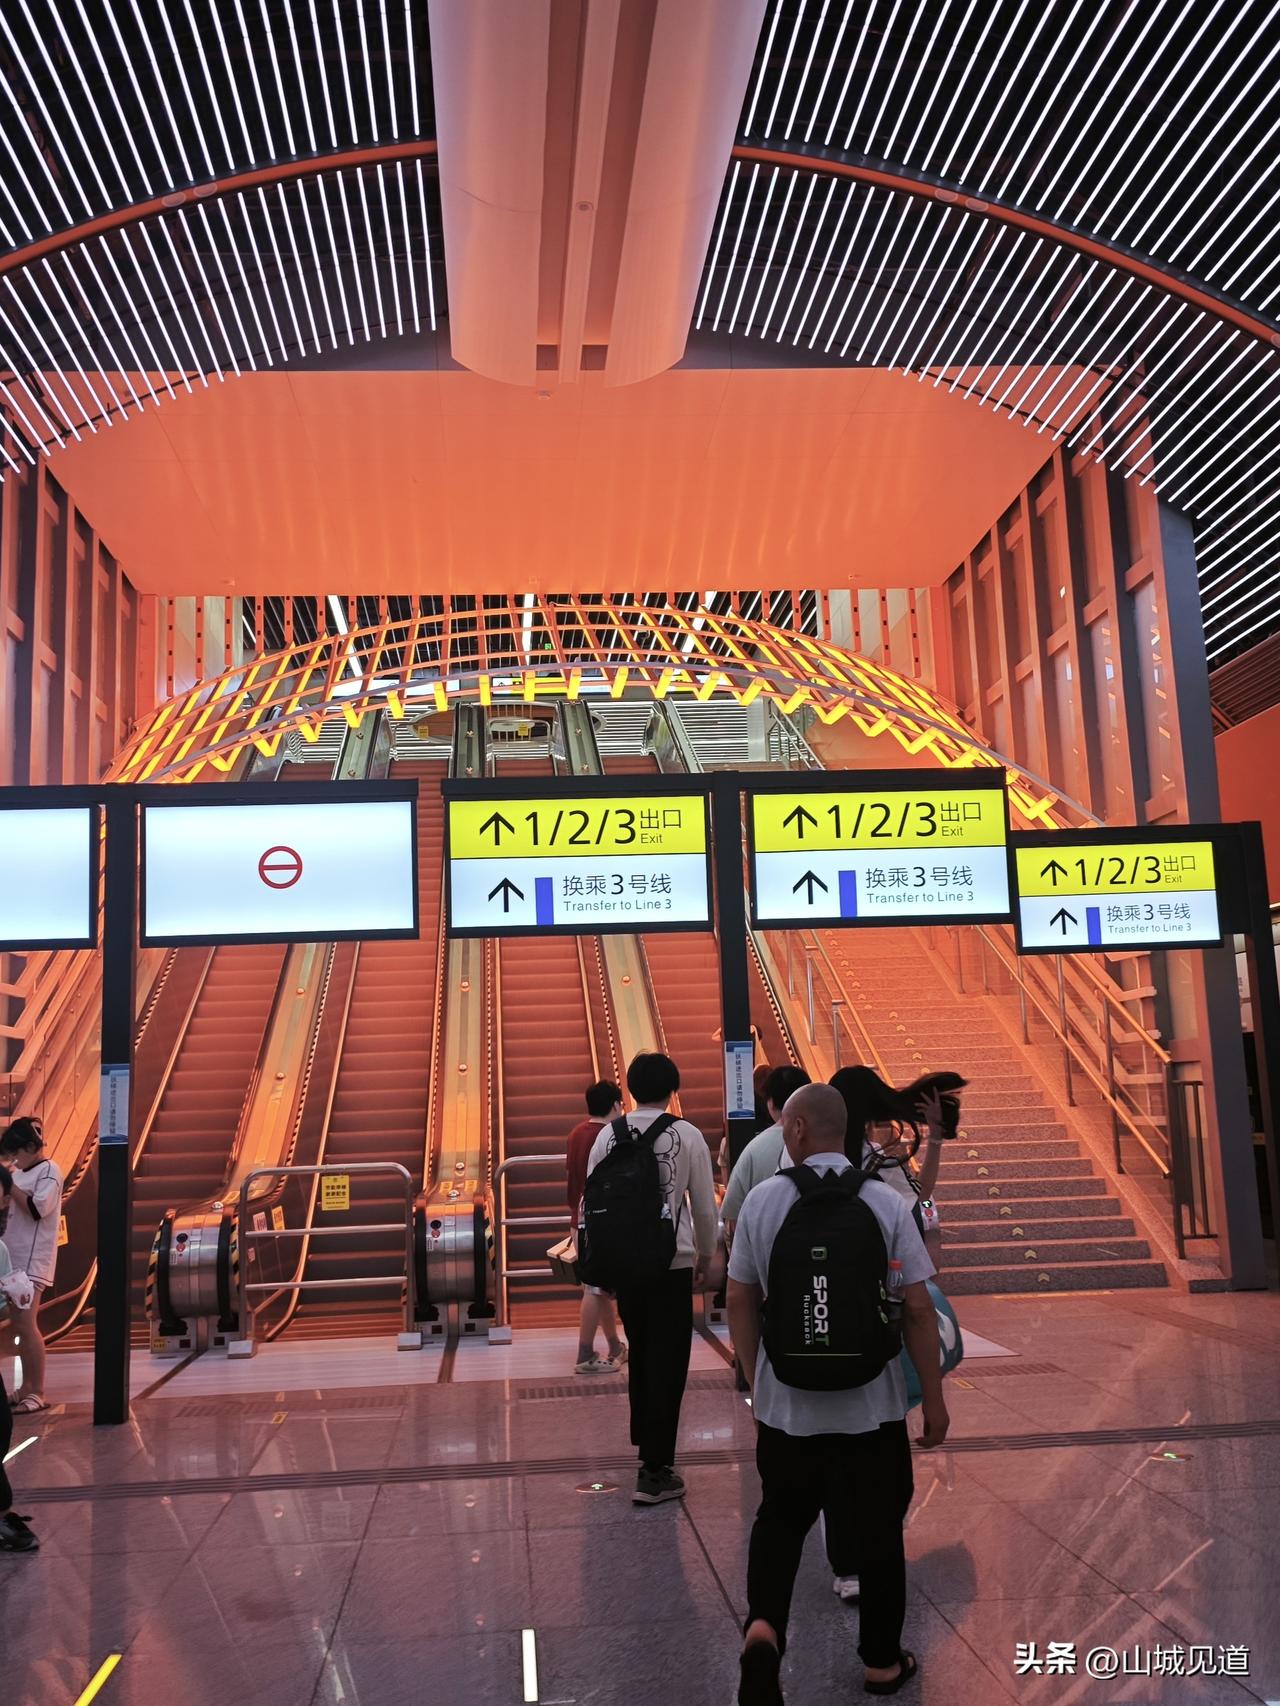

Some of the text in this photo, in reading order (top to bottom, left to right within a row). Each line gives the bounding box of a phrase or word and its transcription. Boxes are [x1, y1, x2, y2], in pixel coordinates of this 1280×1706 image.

[525, 808, 682, 846] 1/2/3 出口
[827, 801, 982, 839] 1/2/3 出口
[641, 833, 663, 844] Exit
[941, 826, 964, 837] Exit
[865, 865, 973, 889] 换乘3号线
[1075, 855, 1196, 886] 1/2/3 出口
[1164, 875, 1182, 884] Exit
[563, 874, 672, 896] 换乘3号线
[563, 899, 672, 912] Transfer to Line 3
[867, 891, 974, 904] Transfer to Line 3
[1106, 903, 1191, 922] 换乘3号线
[1108, 923, 1192, 934] Transfer to Line 3
[813, 1275, 829, 1346] SPORT
